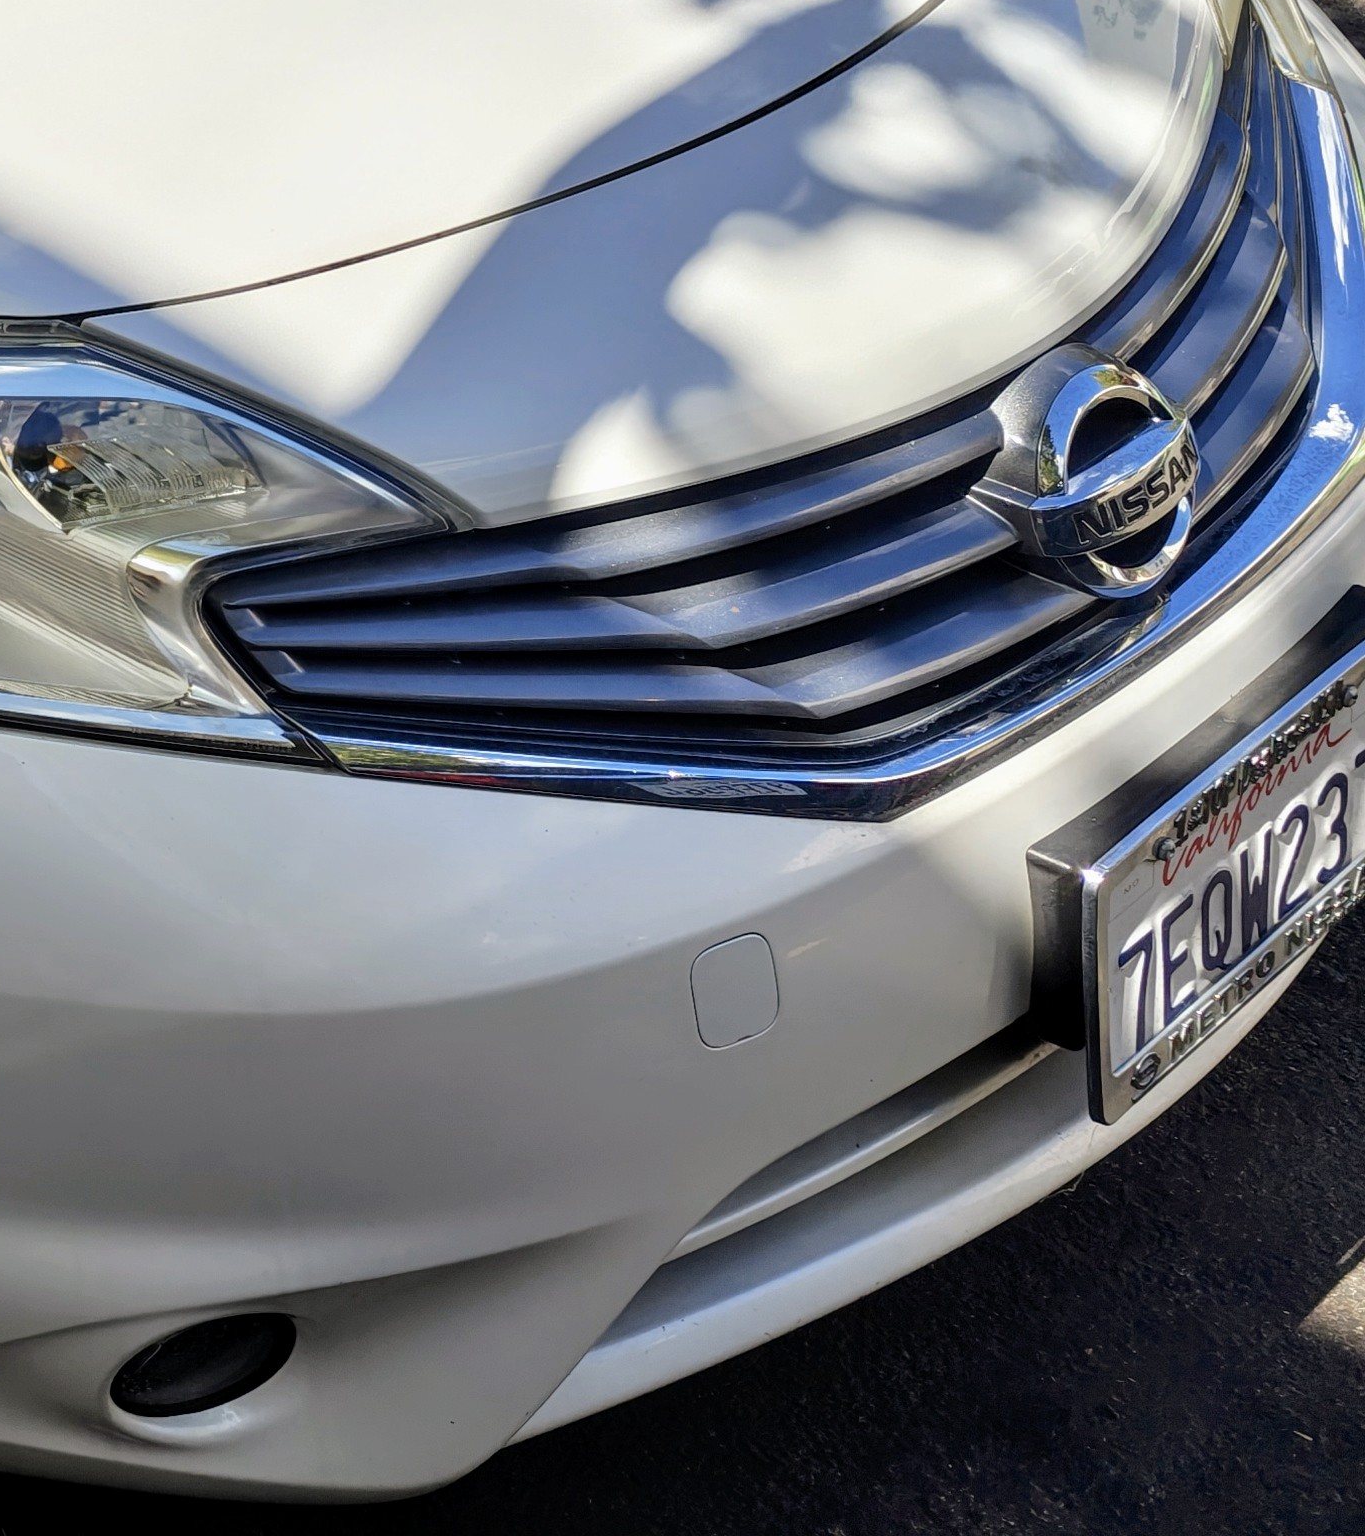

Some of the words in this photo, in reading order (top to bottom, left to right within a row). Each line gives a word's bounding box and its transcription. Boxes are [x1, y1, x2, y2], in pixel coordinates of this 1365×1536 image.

[1071, 444, 1199, 546] NISSAN
[1162, 722, 1352, 887] California
[1118, 750, 1365, 1054] 7EQW23
[1166, 950, 1276, 1063] METRO
[1284, 863, 1365, 952] NISS
